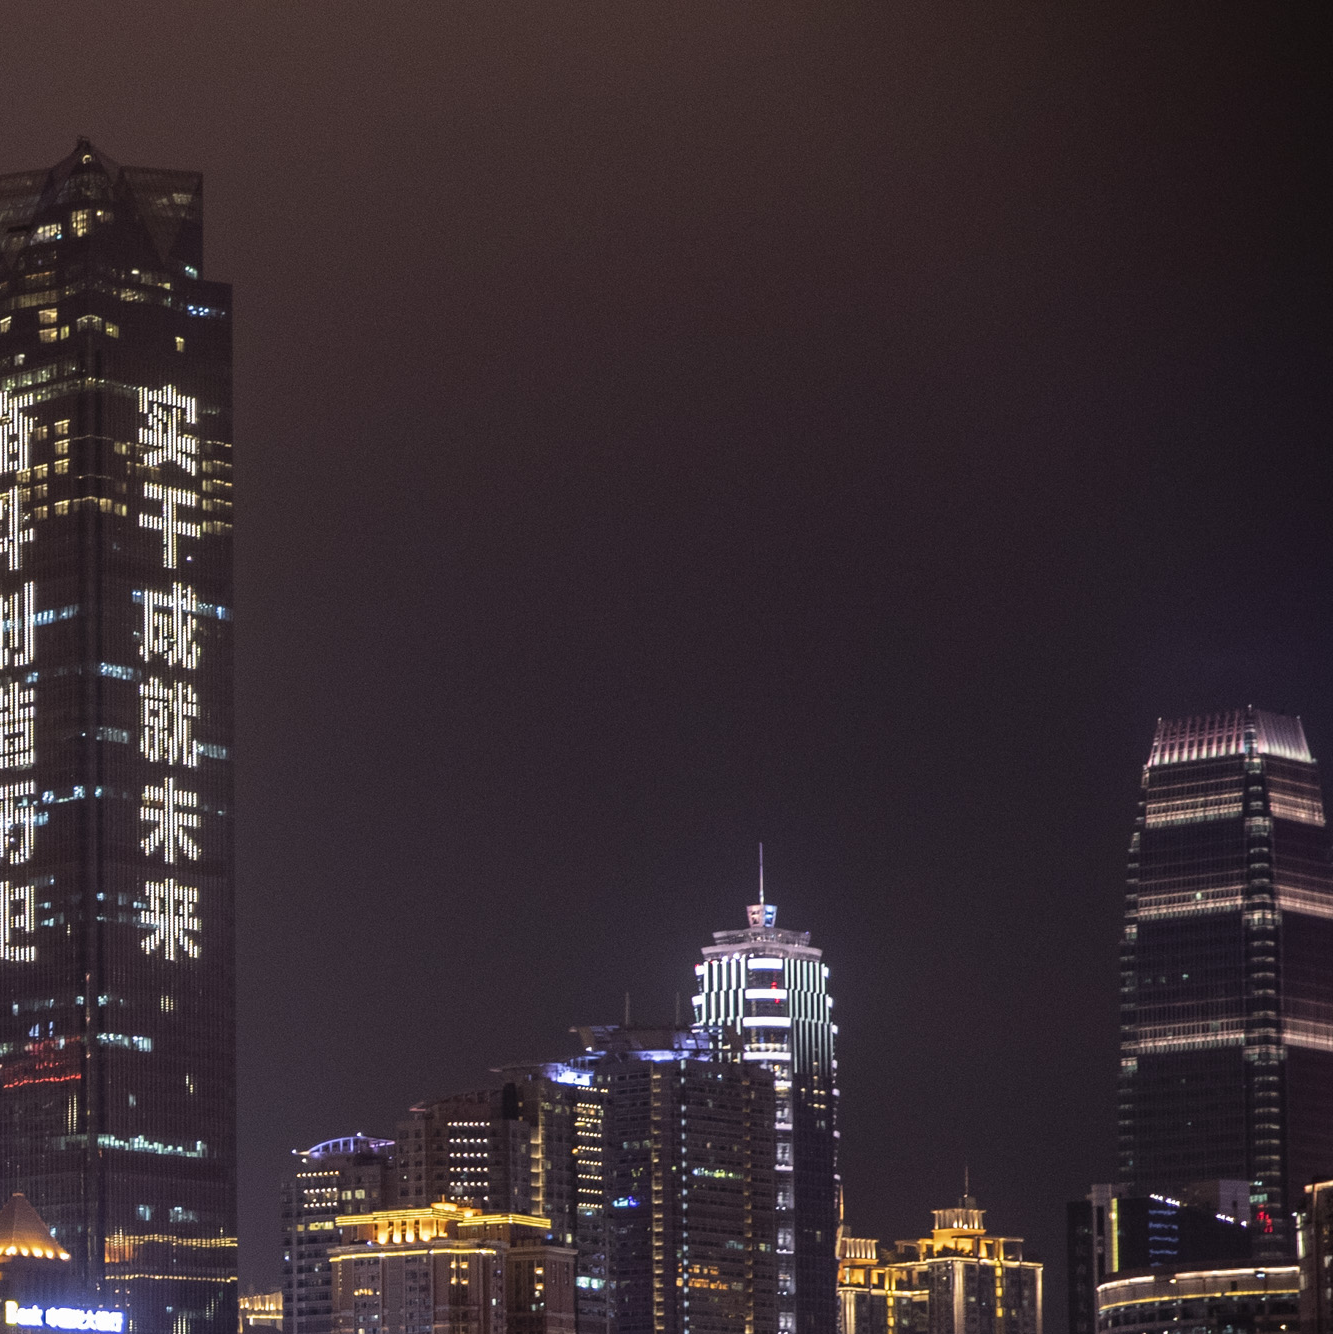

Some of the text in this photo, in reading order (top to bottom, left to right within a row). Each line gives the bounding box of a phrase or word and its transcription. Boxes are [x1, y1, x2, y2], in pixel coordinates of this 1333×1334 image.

[138, 383, 201, 961] 实干成就未来
